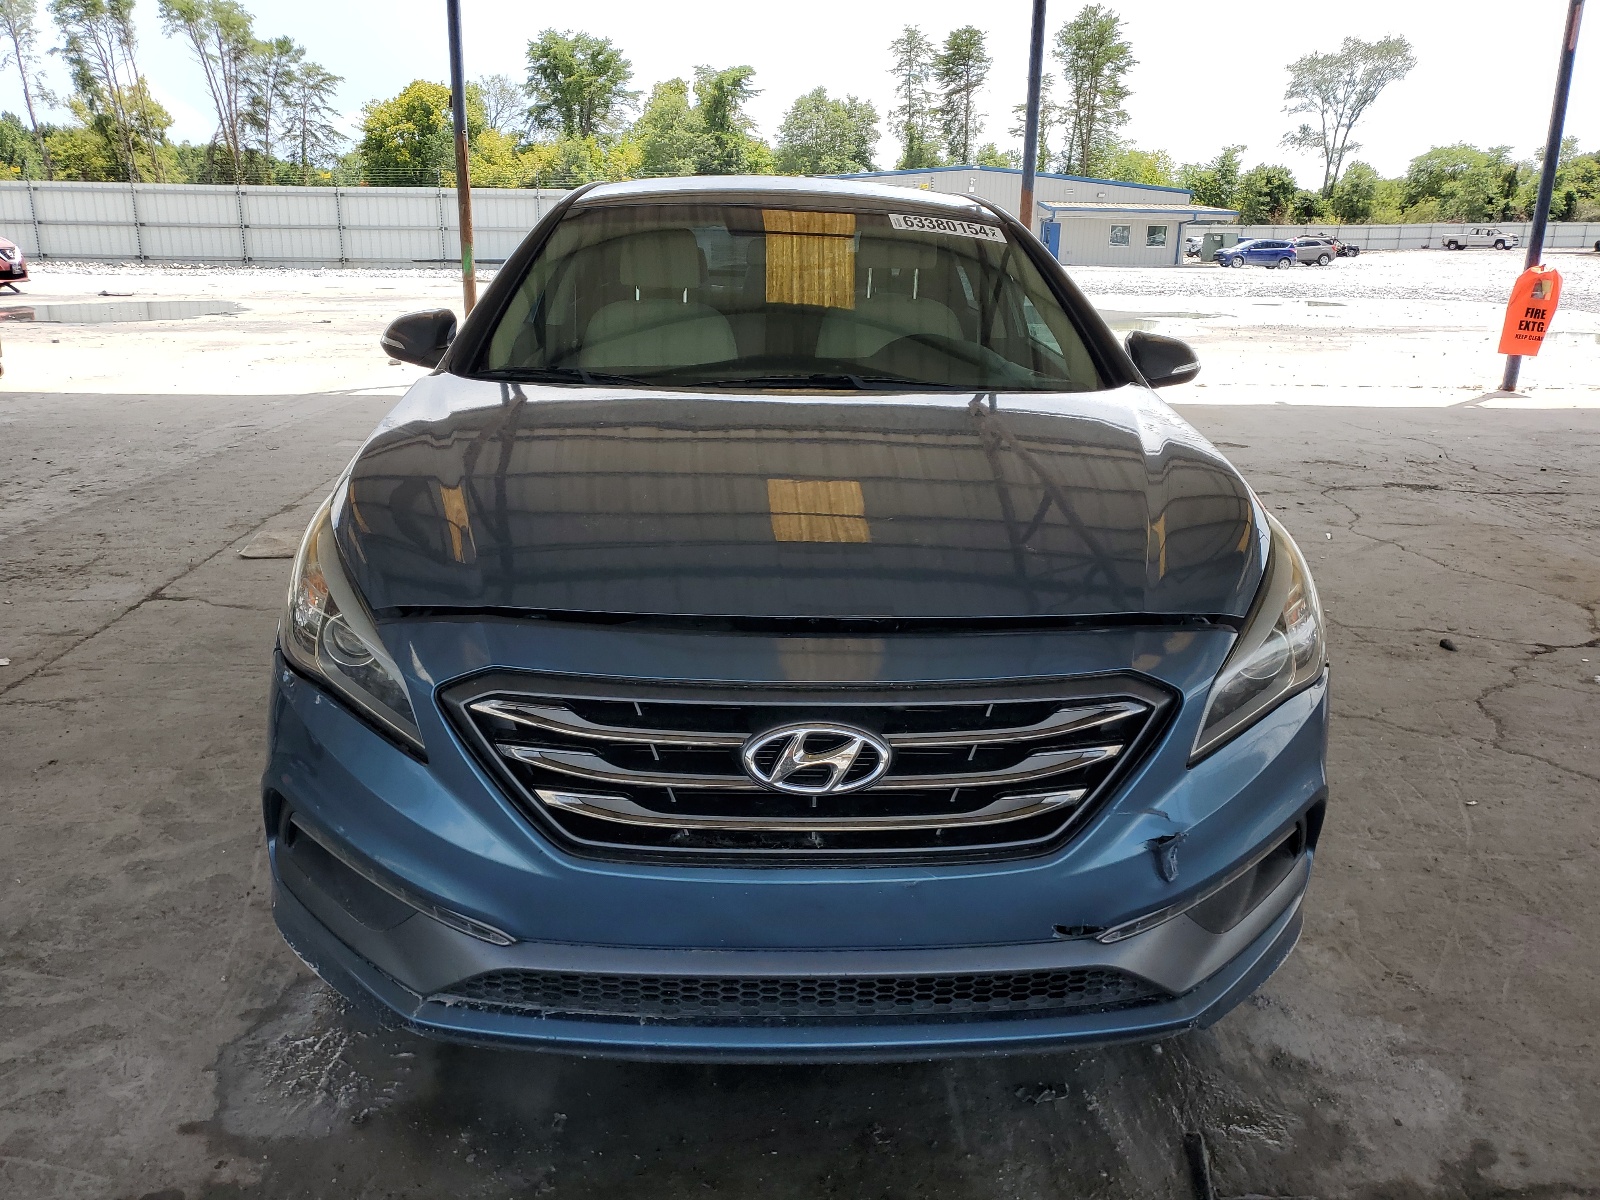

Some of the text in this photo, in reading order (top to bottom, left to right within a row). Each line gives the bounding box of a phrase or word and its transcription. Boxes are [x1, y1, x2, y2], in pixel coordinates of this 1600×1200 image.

[902, 215, 989, 237] 63380154
[1524, 307, 1547, 319] FIRE
[1518, 320, 1546, 333] EXTG.
